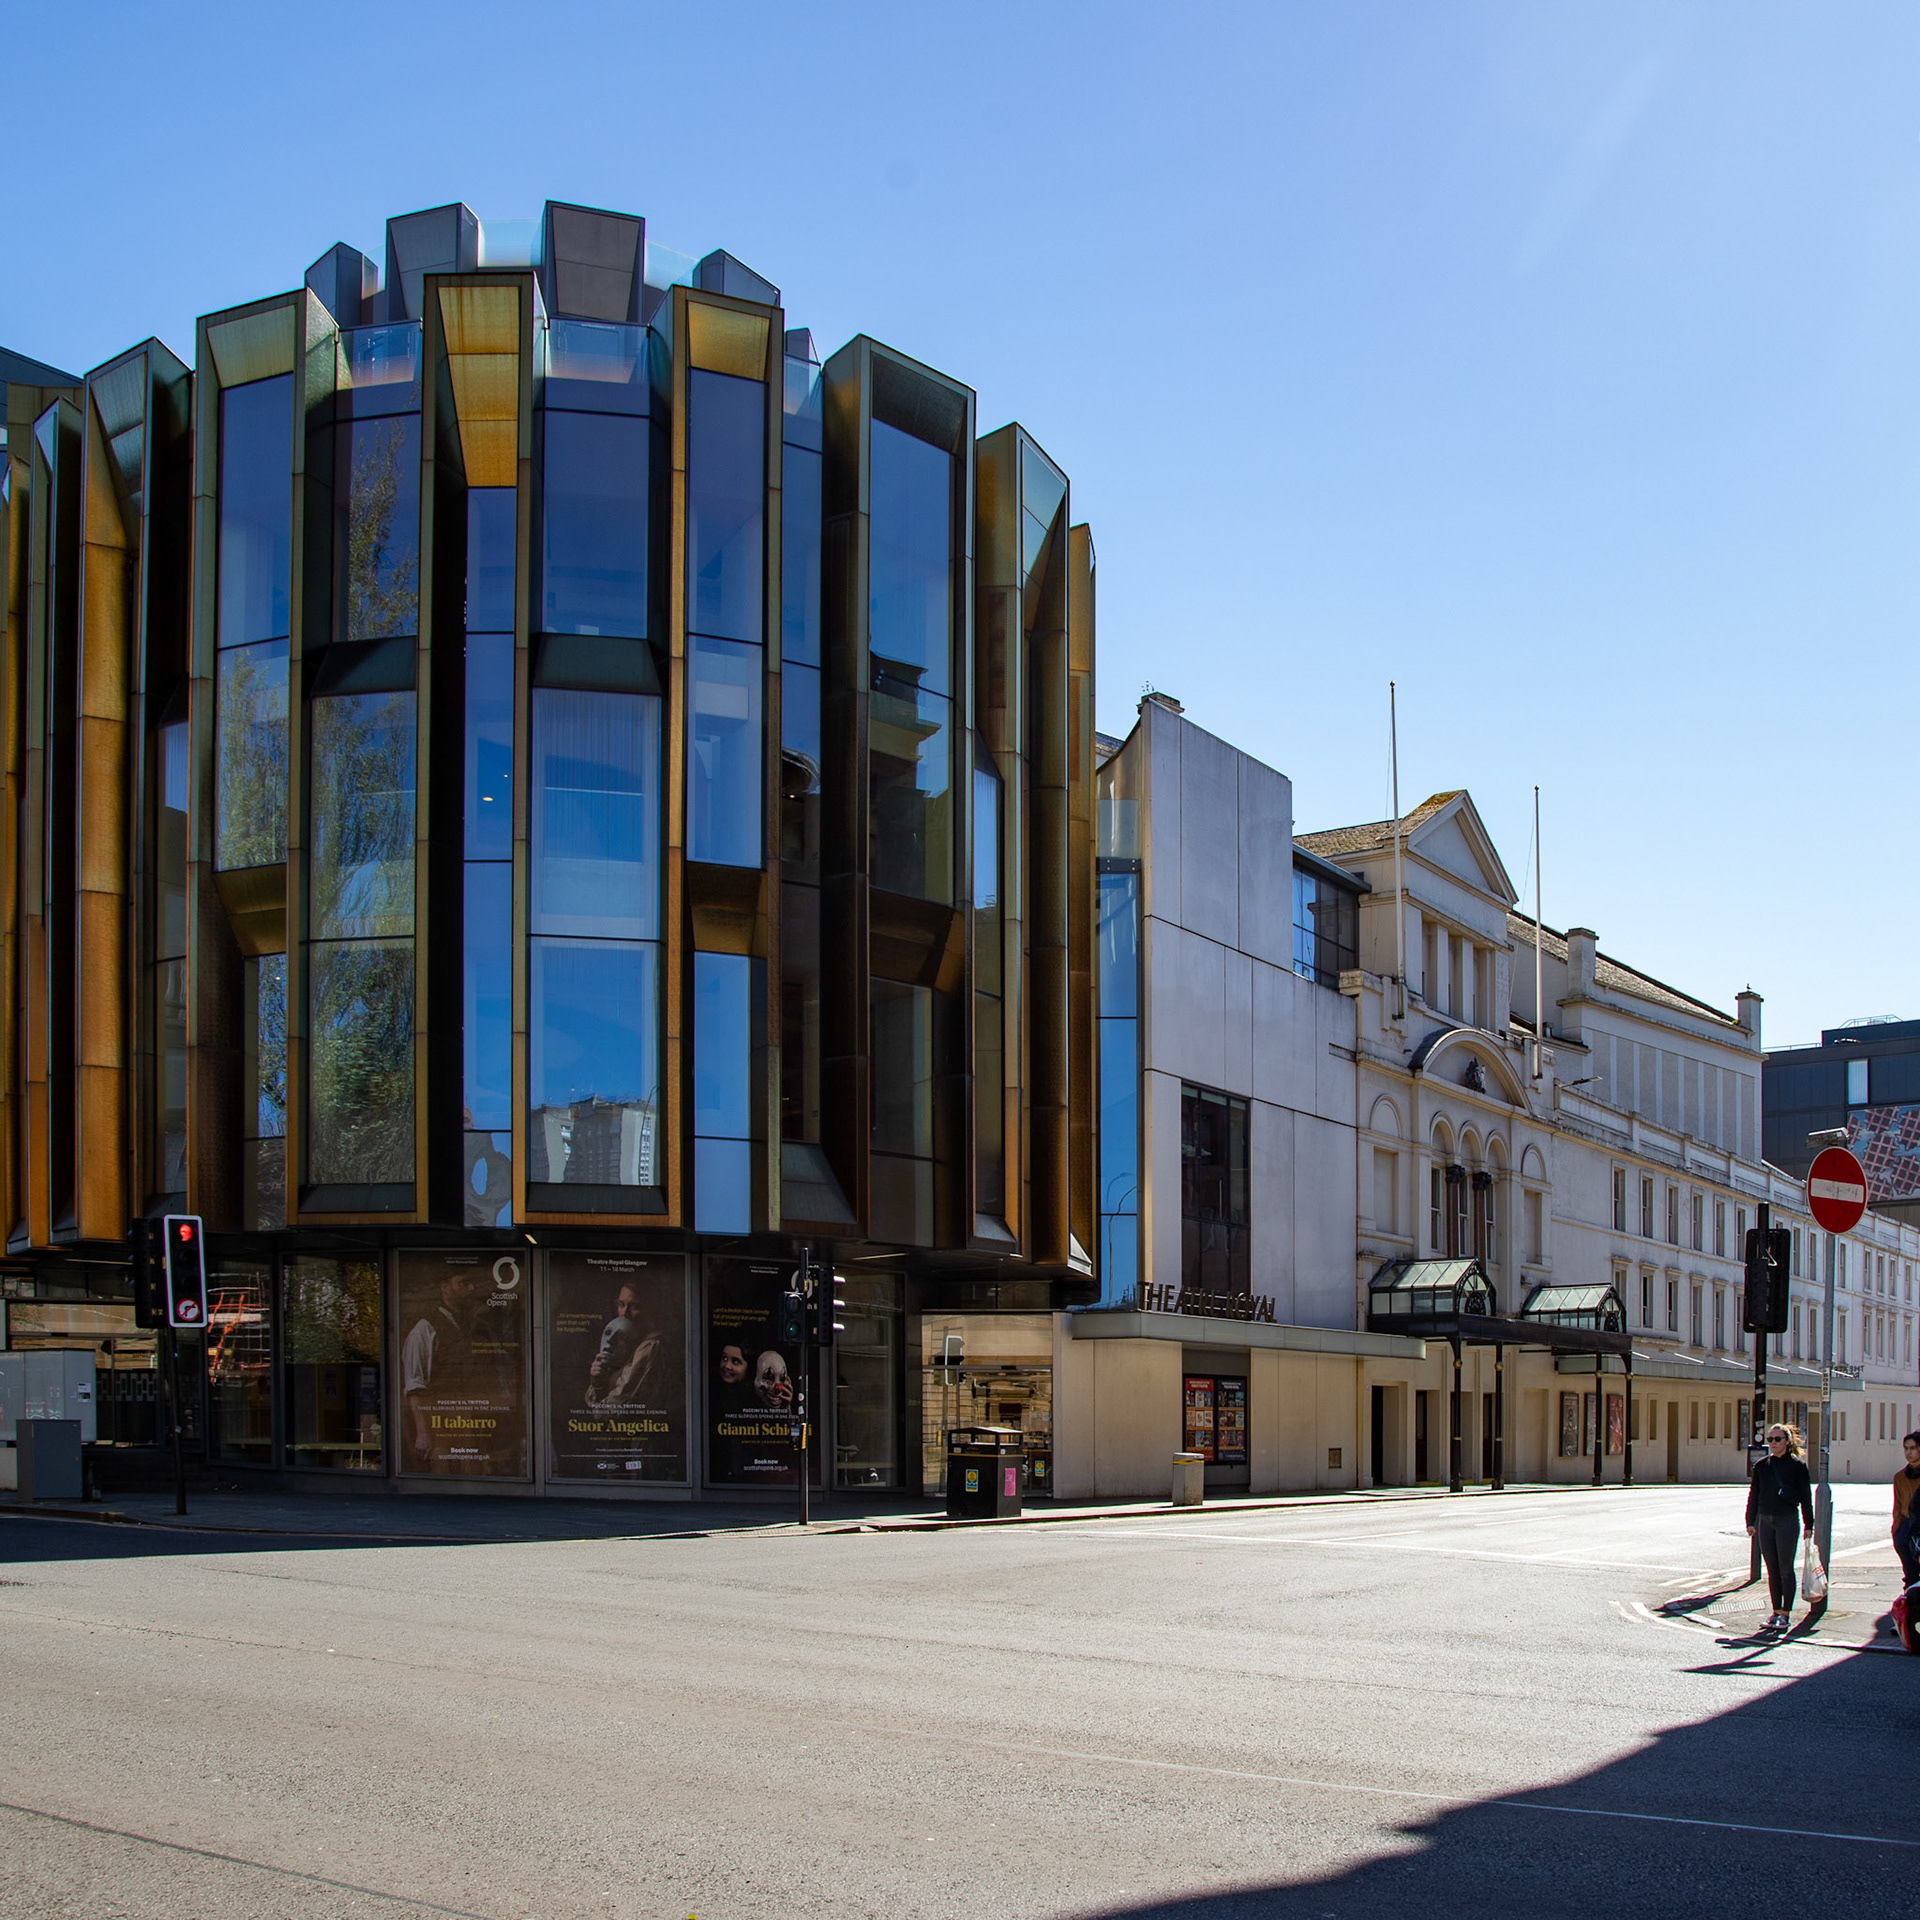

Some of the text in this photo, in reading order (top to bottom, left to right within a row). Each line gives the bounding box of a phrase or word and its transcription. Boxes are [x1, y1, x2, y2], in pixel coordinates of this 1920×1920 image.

[486, 1299, 507, 1307] Opera
[492, 1292, 518, 1300] Scottish
[1137, 1281, 1277, 1323] THEATRE ROYAL
[431, 1415, 497, 1429] Il tabarro
[568, 1419, 669, 1436] Suor Angelica
[717, 1422, 760, 1436] Gianni
